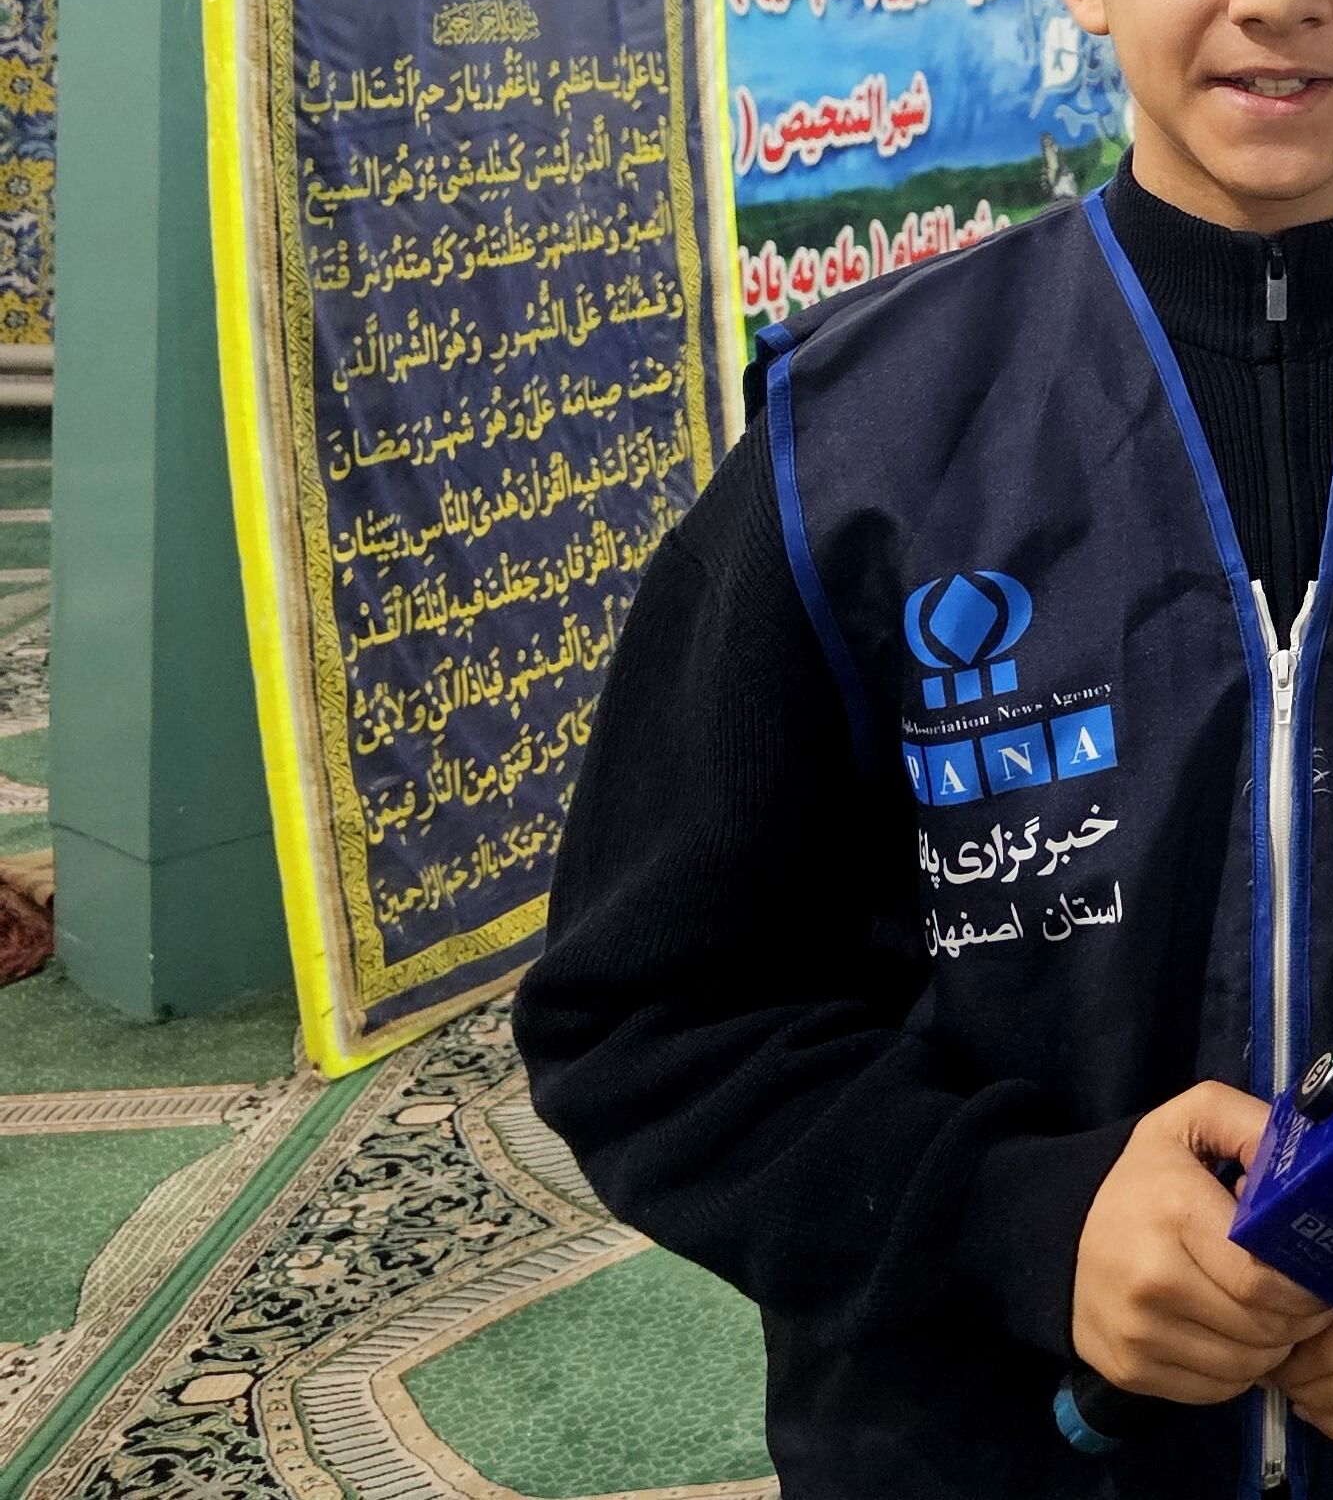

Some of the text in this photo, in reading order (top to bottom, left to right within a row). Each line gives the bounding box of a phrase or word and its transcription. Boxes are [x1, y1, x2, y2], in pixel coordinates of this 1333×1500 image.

[997, 703, 1043, 722] News
[1050, 682, 1113, 708] Agency
[906, 726, 1102, 795] PANA
[942, 804, 1119, 885] خبرگزاری
[924, 880, 1123, 959] استان اصفهان
